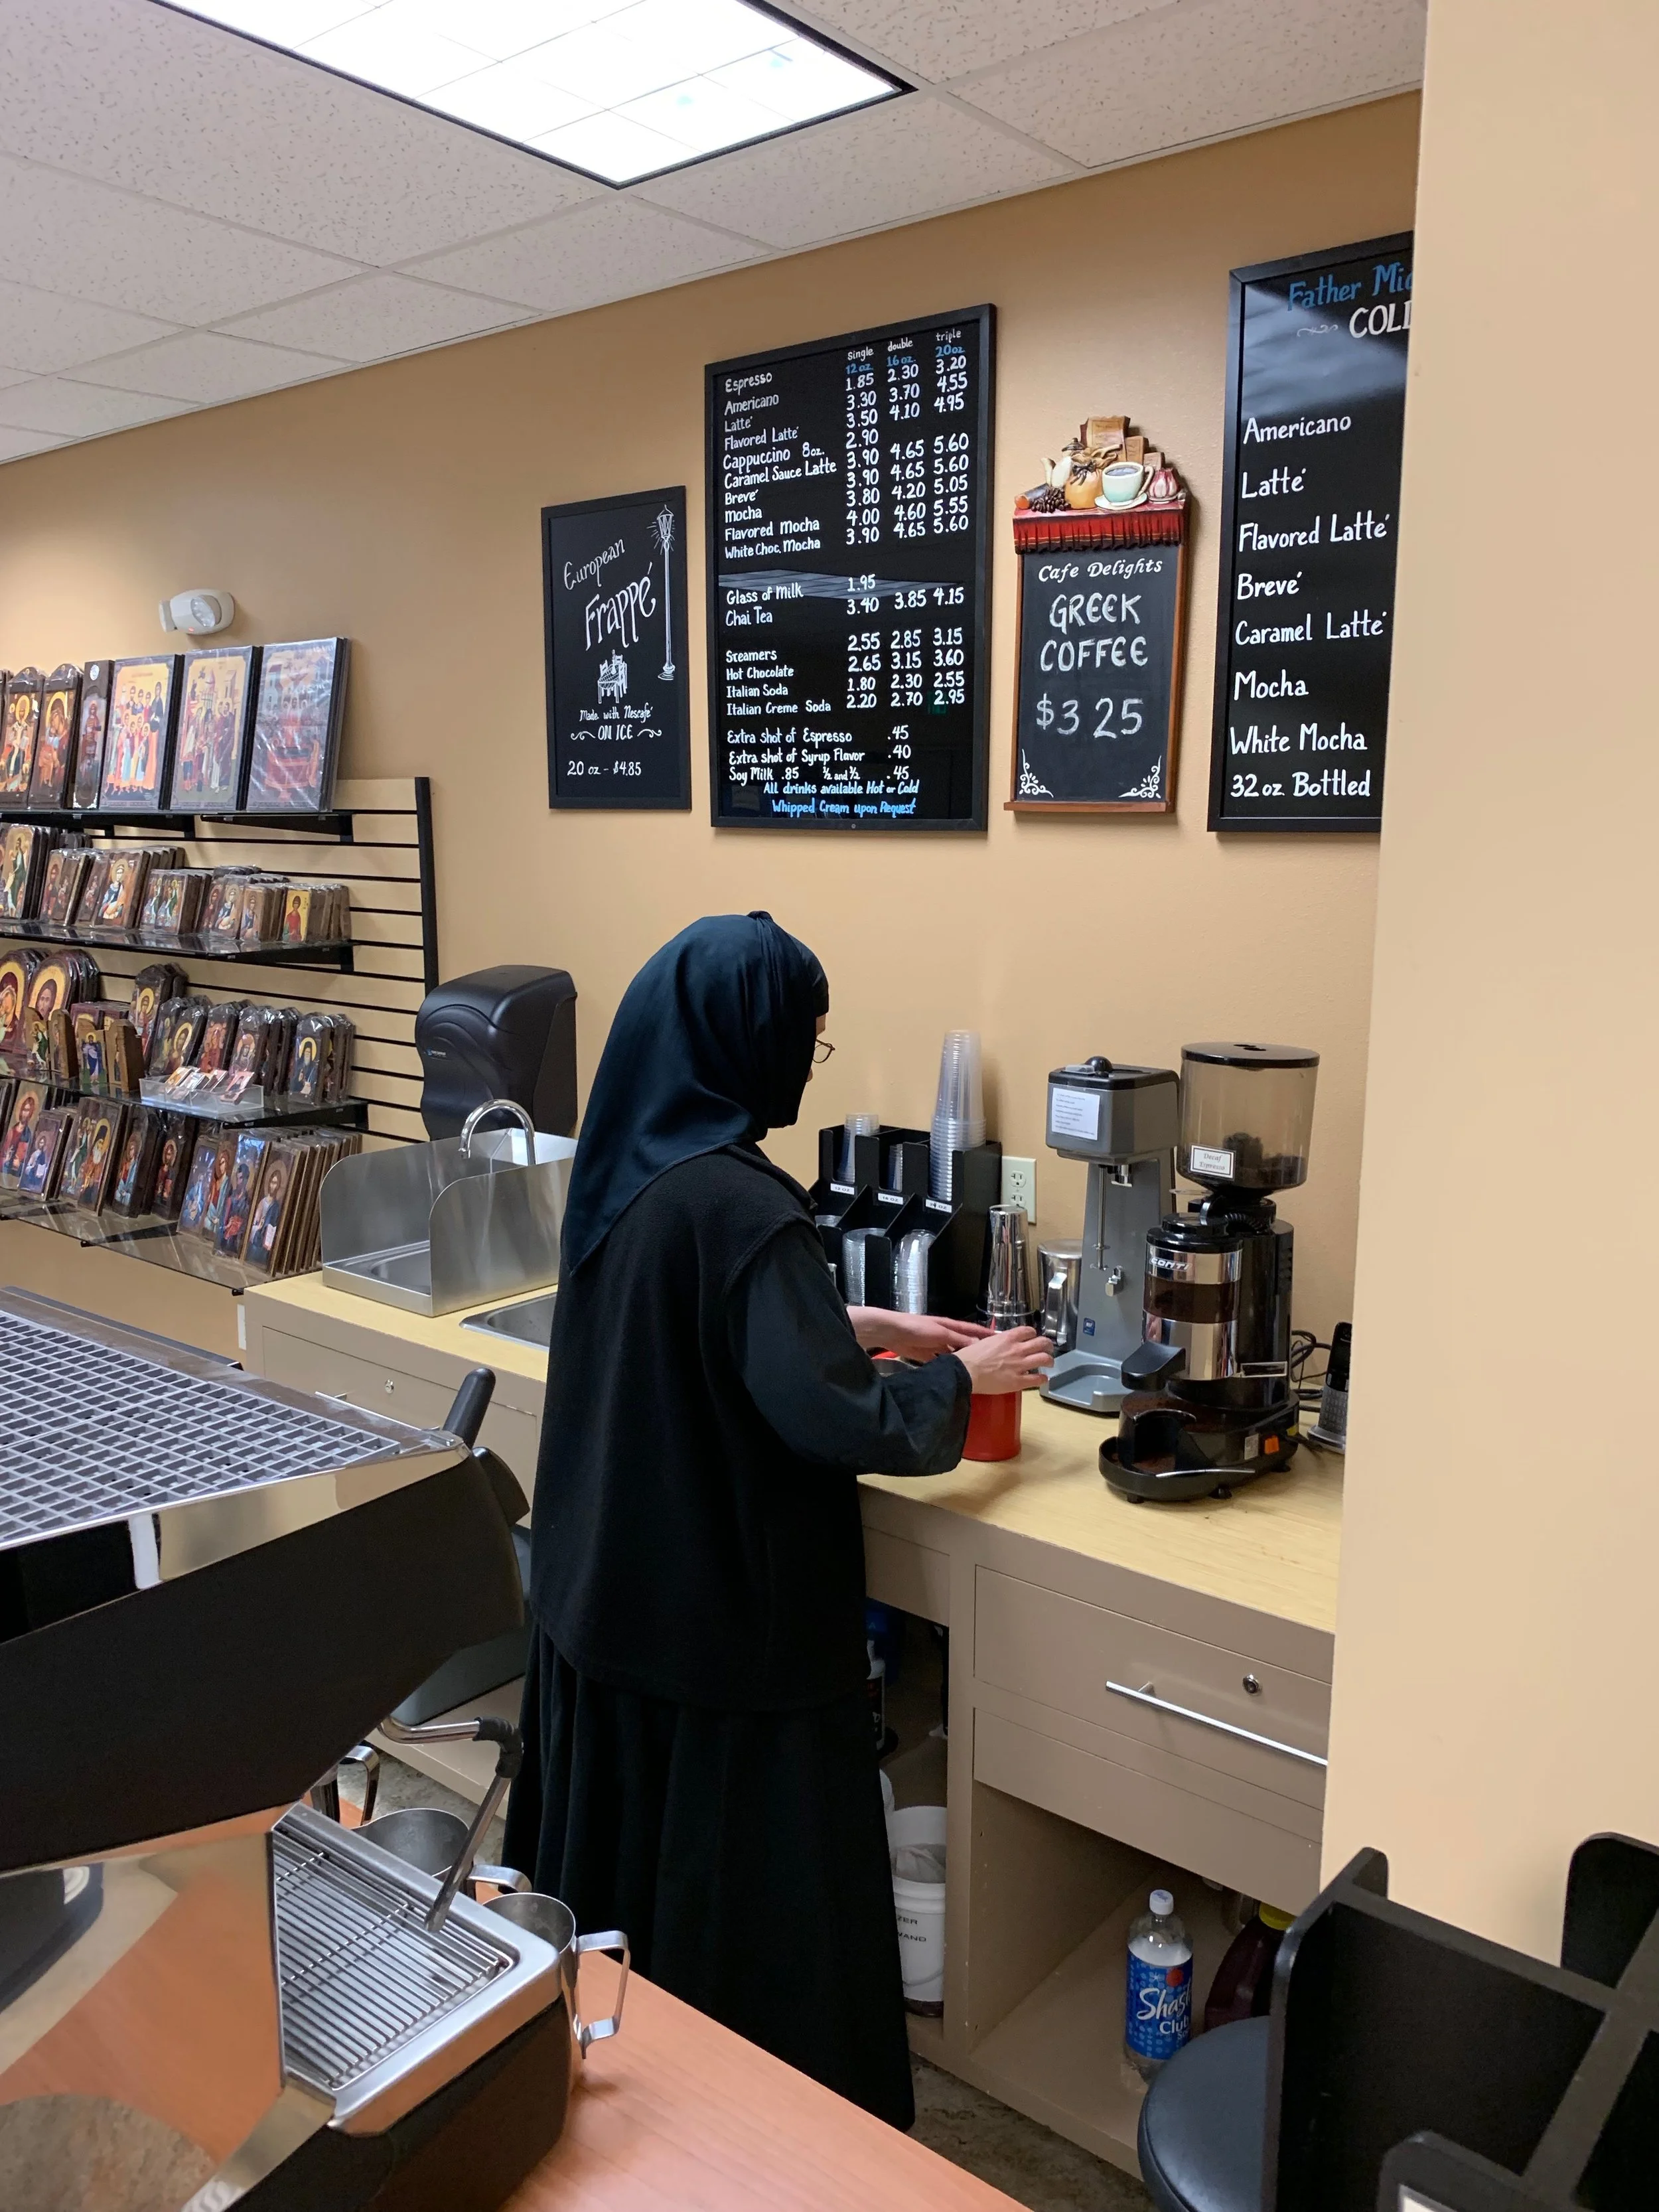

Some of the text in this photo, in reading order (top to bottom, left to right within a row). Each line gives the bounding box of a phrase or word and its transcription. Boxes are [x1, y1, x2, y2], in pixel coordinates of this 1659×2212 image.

[1287, 274, 1362, 311] Father
[888, 337, 913, 352] double
[936, 329, 961, 343] triple
[725, 372, 772, 396] Espresso
[725, 355, 966, 415] Americano 1.85 2.30 3.20
[847, 391, 876, 410] 3.30
[889, 383, 920, 402] 3.70
[937, 372, 968, 392] 4.55
[725, 425, 766, 451] Flavored
[847, 409, 877, 428] 3.50
[889, 402, 920, 421] 4.10
[934, 392, 964, 413] 4.95
[1242, 413, 1351, 444] Americano
[723, 447, 790, 474] Cappuccino
[846, 429, 879, 449] 2.90
[725, 433, 969, 489] Caramel Sauce Latte 3.90 4.65 5.60
[847, 469, 879, 488] 3.90
[891, 461, 924, 481] 4.65
[934, 454, 968, 474] 5.60
[847, 488, 879, 506] 3.80
[892, 482, 926, 500] 4.20
[934, 474, 968, 494] 5.05
[725, 521, 773, 541] Flavored
[846, 508, 879, 526] 4.00
[894, 502, 926, 521] 4.60
[934, 495, 968, 516] 5.55
[1239, 516, 1319, 552] Flavored
[725, 545, 754, 558] White
[756, 542, 781, 555] Choc.
[846, 526, 879, 544] 3.90
[893, 521, 925, 538] 4.65
[934, 515, 968, 534] 5.60
[564, 540, 624, 589] European
[1039, 558, 1163, 583] Cafe Delights
[583, 559, 656, 650] Frappé
[727, 589, 758, 605] Glass
[762, 584, 773, 601] of
[847, 574, 876, 593] 1.95
[726, 587, 964, 626] Chai Tea 3.40 3.85 4.15
[1050, 593, 1141, 634] GREEK
[726, 627, 962, 662] Steamers 2.55 2.85 3.15
[1236, 613, 1313, 645] Caramel
[727, 648, 964, 680] Hot Chocolate 2.65 3.15 3.60
[1041, 636, 1147, 671] COFFEE
[727, 670, 964, 698] Italian Soda 1.80 2.30 2.55
[1234, 670, 1309, 700] Mocha
[603, 707, 620, 719] with
[727, 689, 964, 715] Italian Creme Soda 2.20 2.70 2.95
[598, 724, 632, 740] ON ICE
[727, 725, 908, 749] Extra shot of Espresso .45
[1230, 722, 1368, 755] White Mocha
[567, 761, 584, 775] 20
[613, 761, 641, 776] $4.85
[729, 745, 911, 766] Extra shot of Syrup Flavor .40
[729, 767, 747, 786] Soy
[782, 767, 799, 780] .85
[834, 770, 848, 780] and
[887, 766, 909, 780] .45
[764, 782, 778, 794] All
[783, 782, 817, 794] drinks
[820, 781, 863, 794] available
[866, 780, 885, 794] Hot
[898, 779, 919, 794] Cold
[1292, 769, 1370, 796] Bottled
[772, 798, 916, 818] Whipped Cream upon Request
[1204, 1153, 1223, 1163] Decaf
[1151, 1256, 1190, 1271] CONTI
